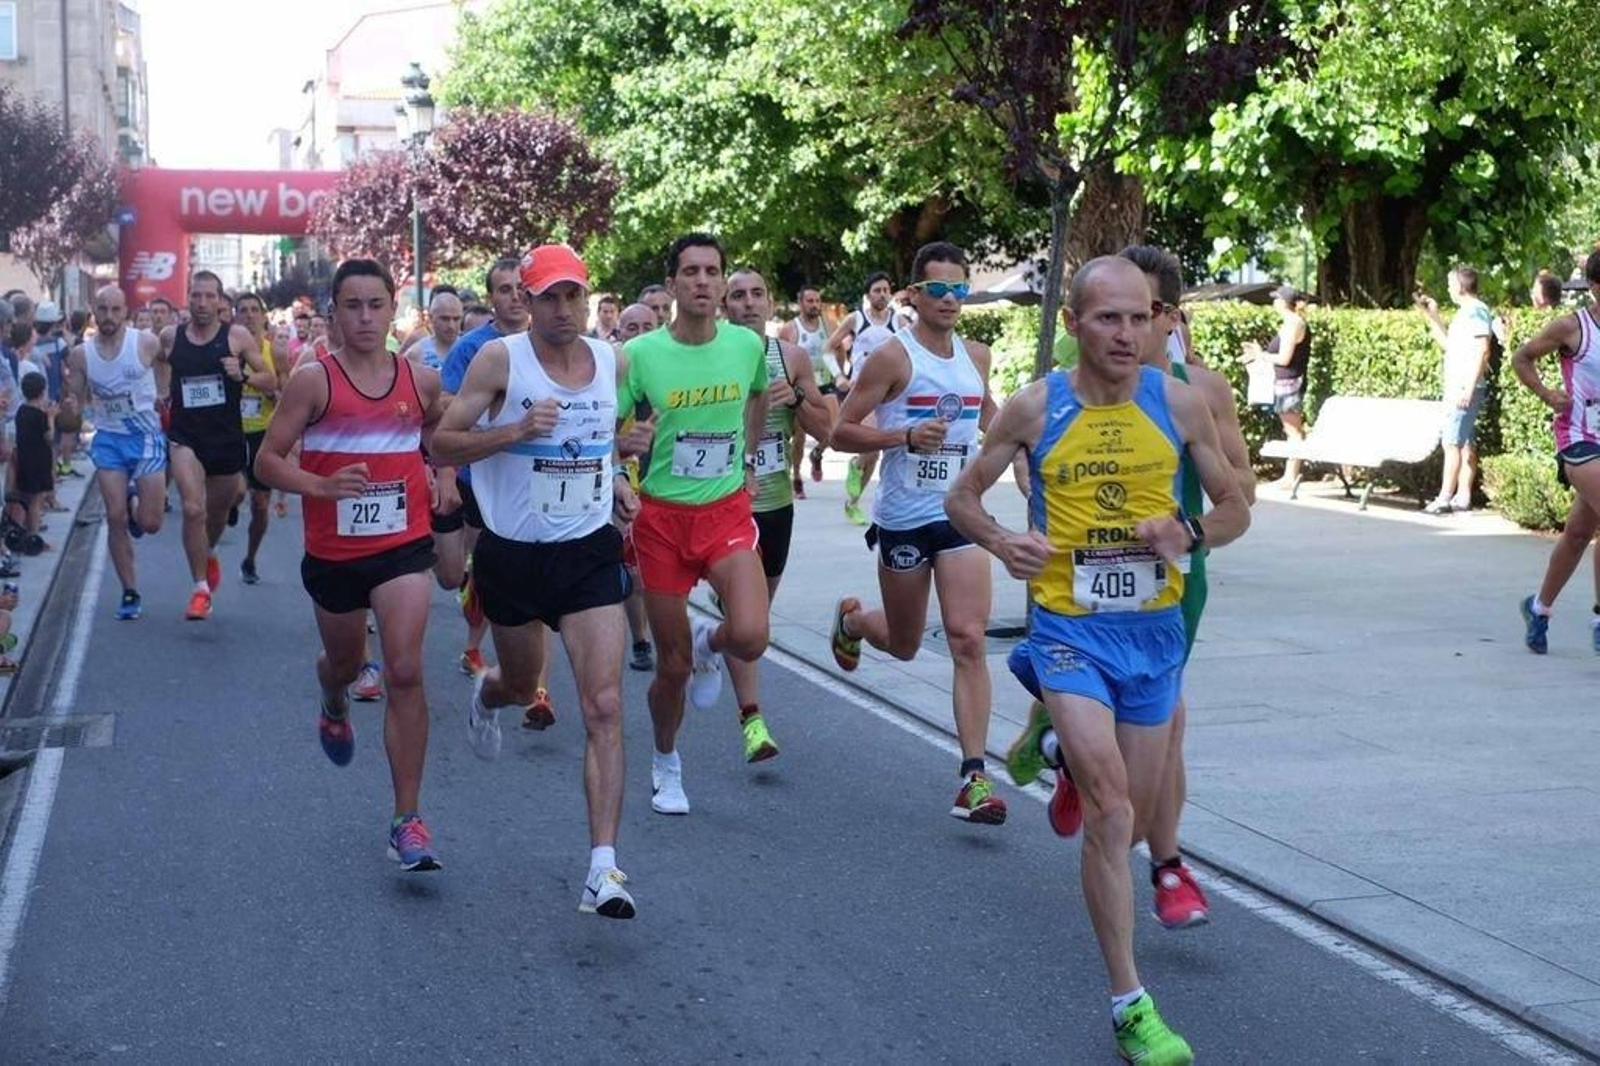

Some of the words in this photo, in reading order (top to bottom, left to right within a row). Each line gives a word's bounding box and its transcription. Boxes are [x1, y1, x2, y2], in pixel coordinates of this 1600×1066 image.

[180, 186, 267, 217] new
[695, 449, 706, 467] 2
[917, 460, 948, 480] 356
[1074, 460, 1119, 483] poio
[560, 480, 566, 502] 1
[352, 502, 380, 524] 212
[1091, 571, 1135, 598] 409
